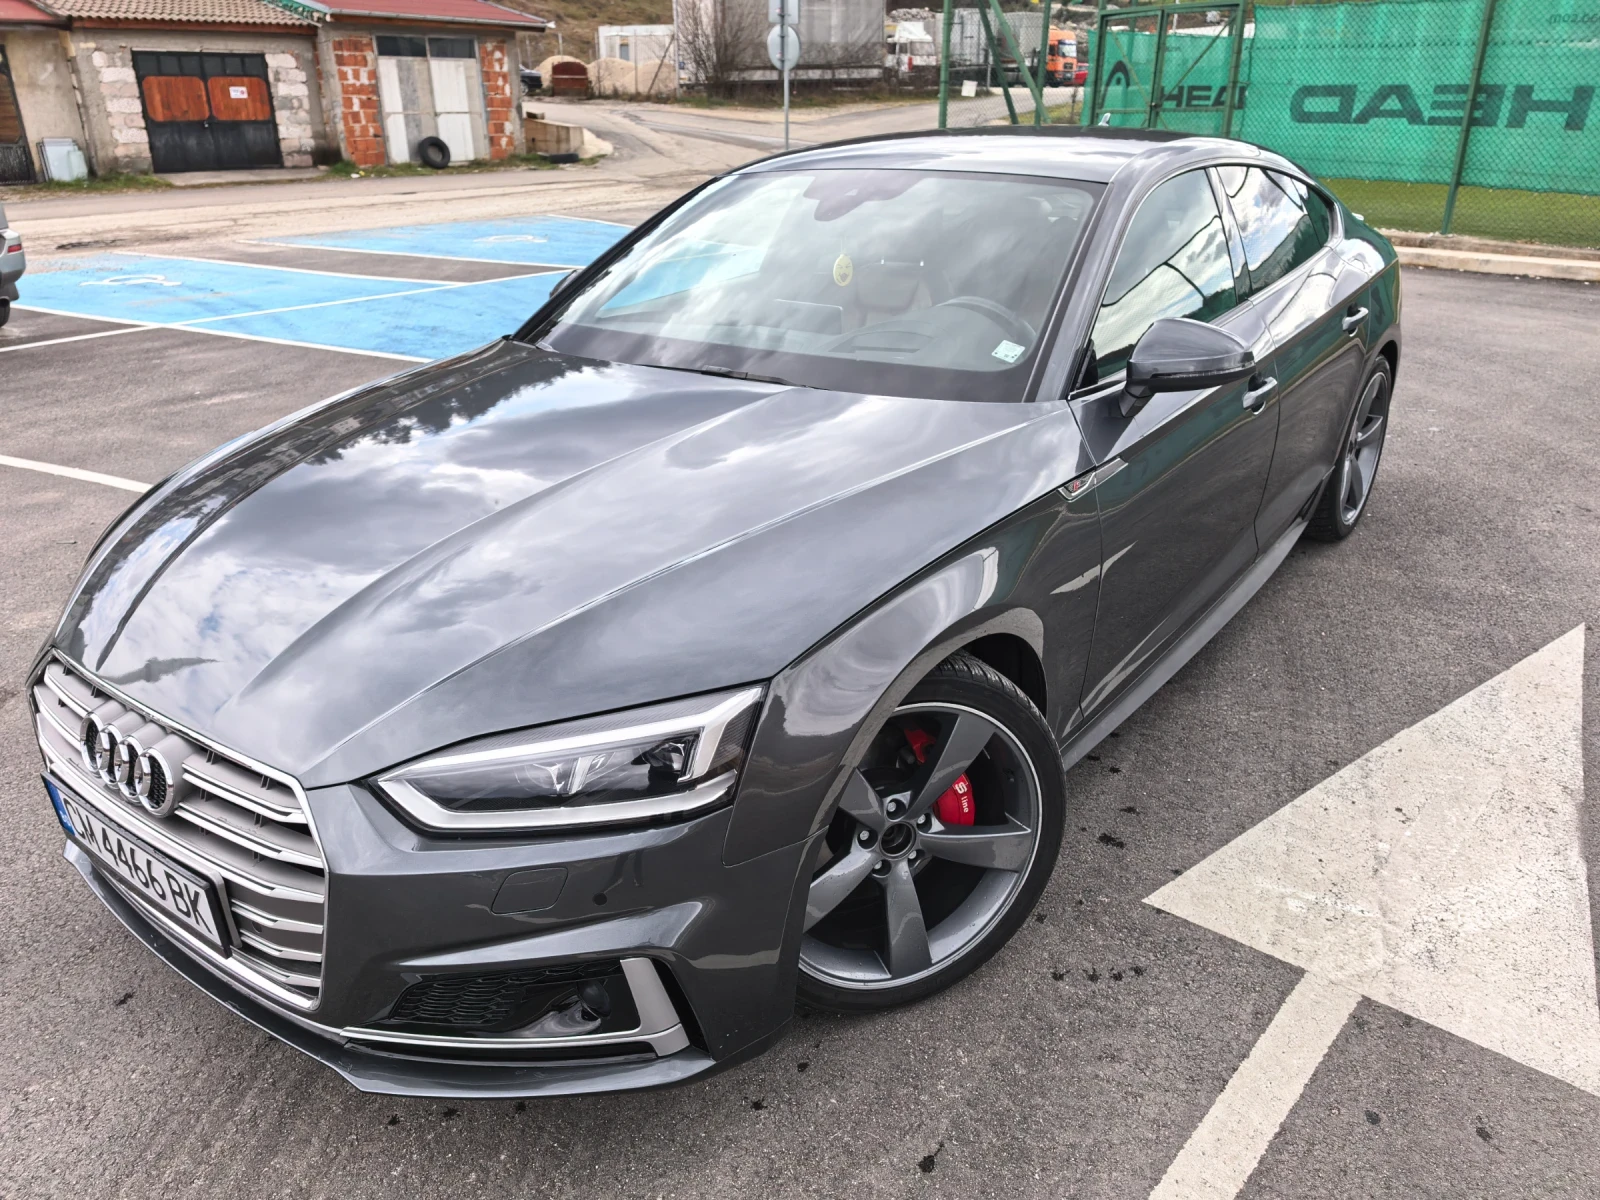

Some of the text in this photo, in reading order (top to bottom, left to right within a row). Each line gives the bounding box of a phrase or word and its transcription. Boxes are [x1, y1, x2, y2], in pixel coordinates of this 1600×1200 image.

[955, 781, 969, 813] S line
[63, 798, 213, 934] CM 4466 BK
